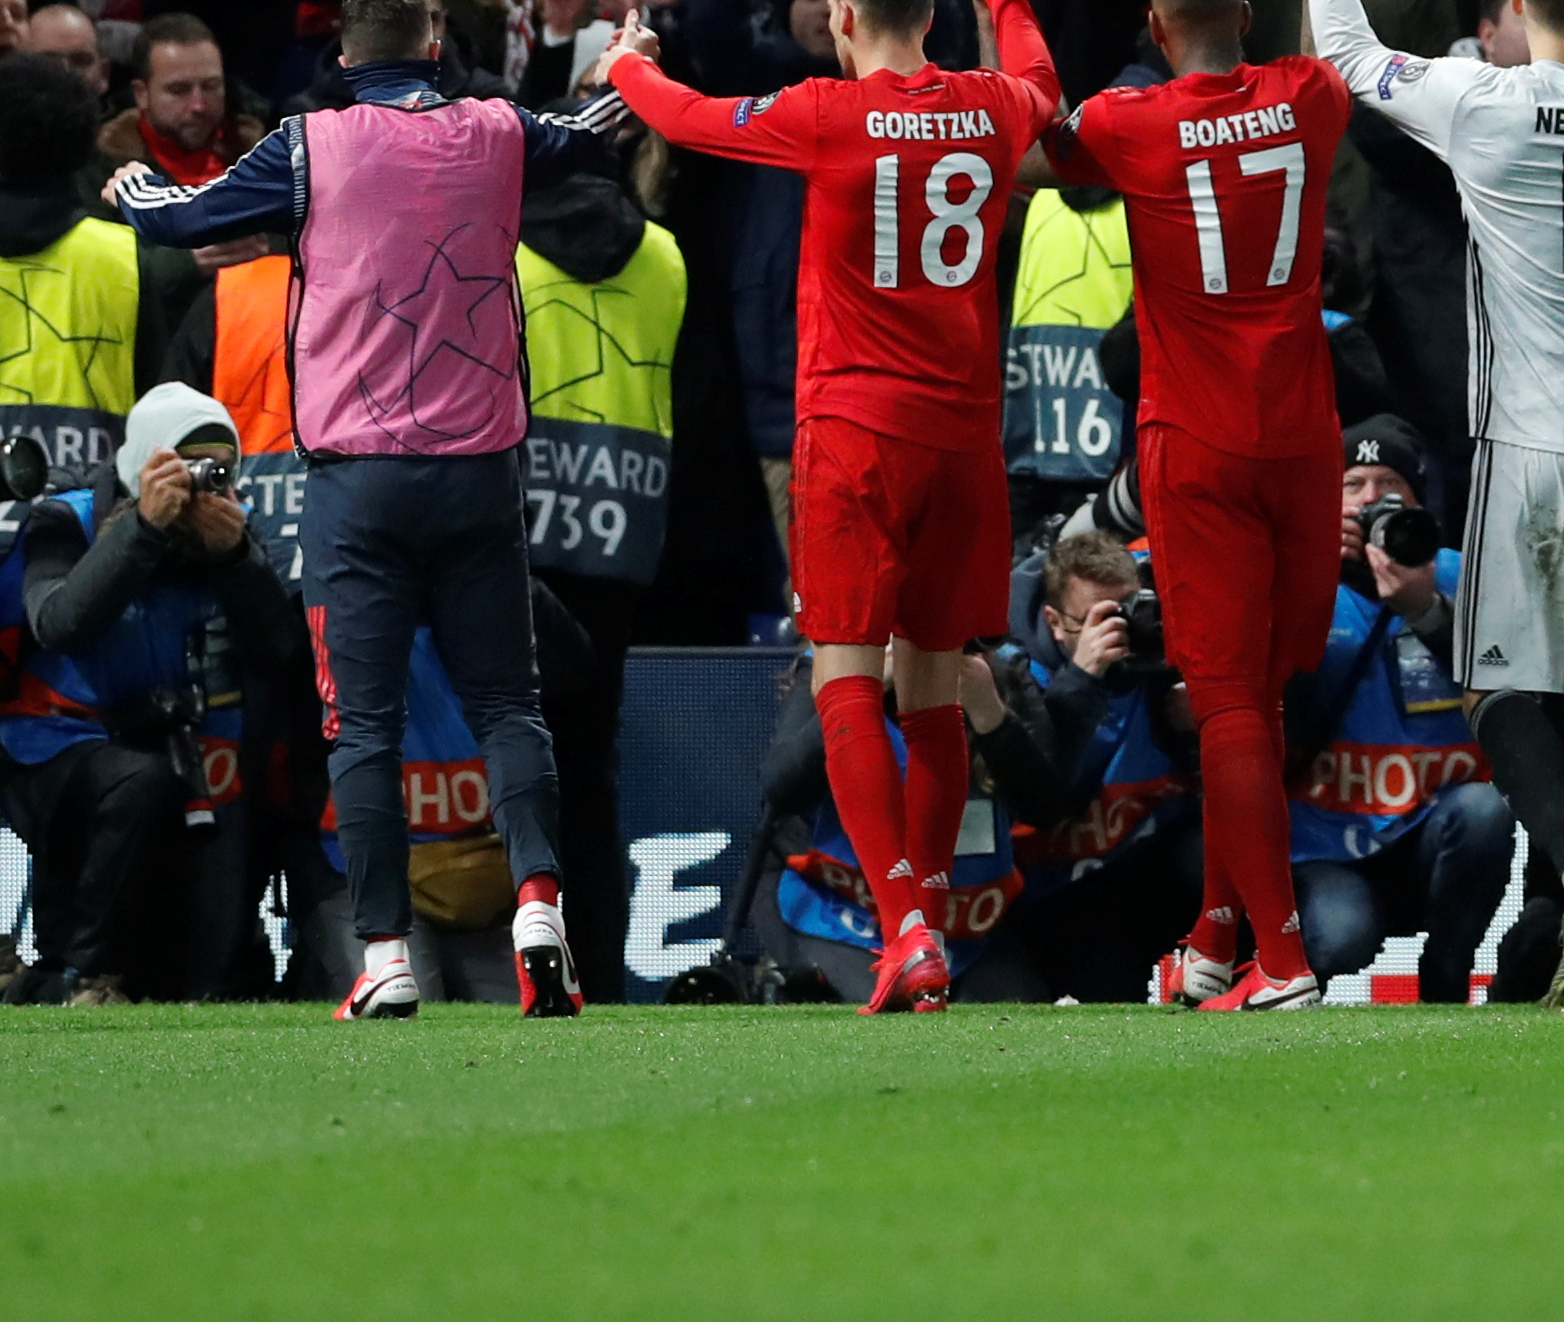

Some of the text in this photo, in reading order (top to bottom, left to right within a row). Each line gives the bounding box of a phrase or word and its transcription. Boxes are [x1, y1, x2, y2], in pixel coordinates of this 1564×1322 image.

[867, 109, 995, 140] GORETZKA
[1179, 102, 1296, 149] BOATENG
[874, 152, 994, 289] 18
[1185, 141, 1306, 295] 17
[525, 437, 669, 498] EWARD
[525, 488, 628, 557] 739
